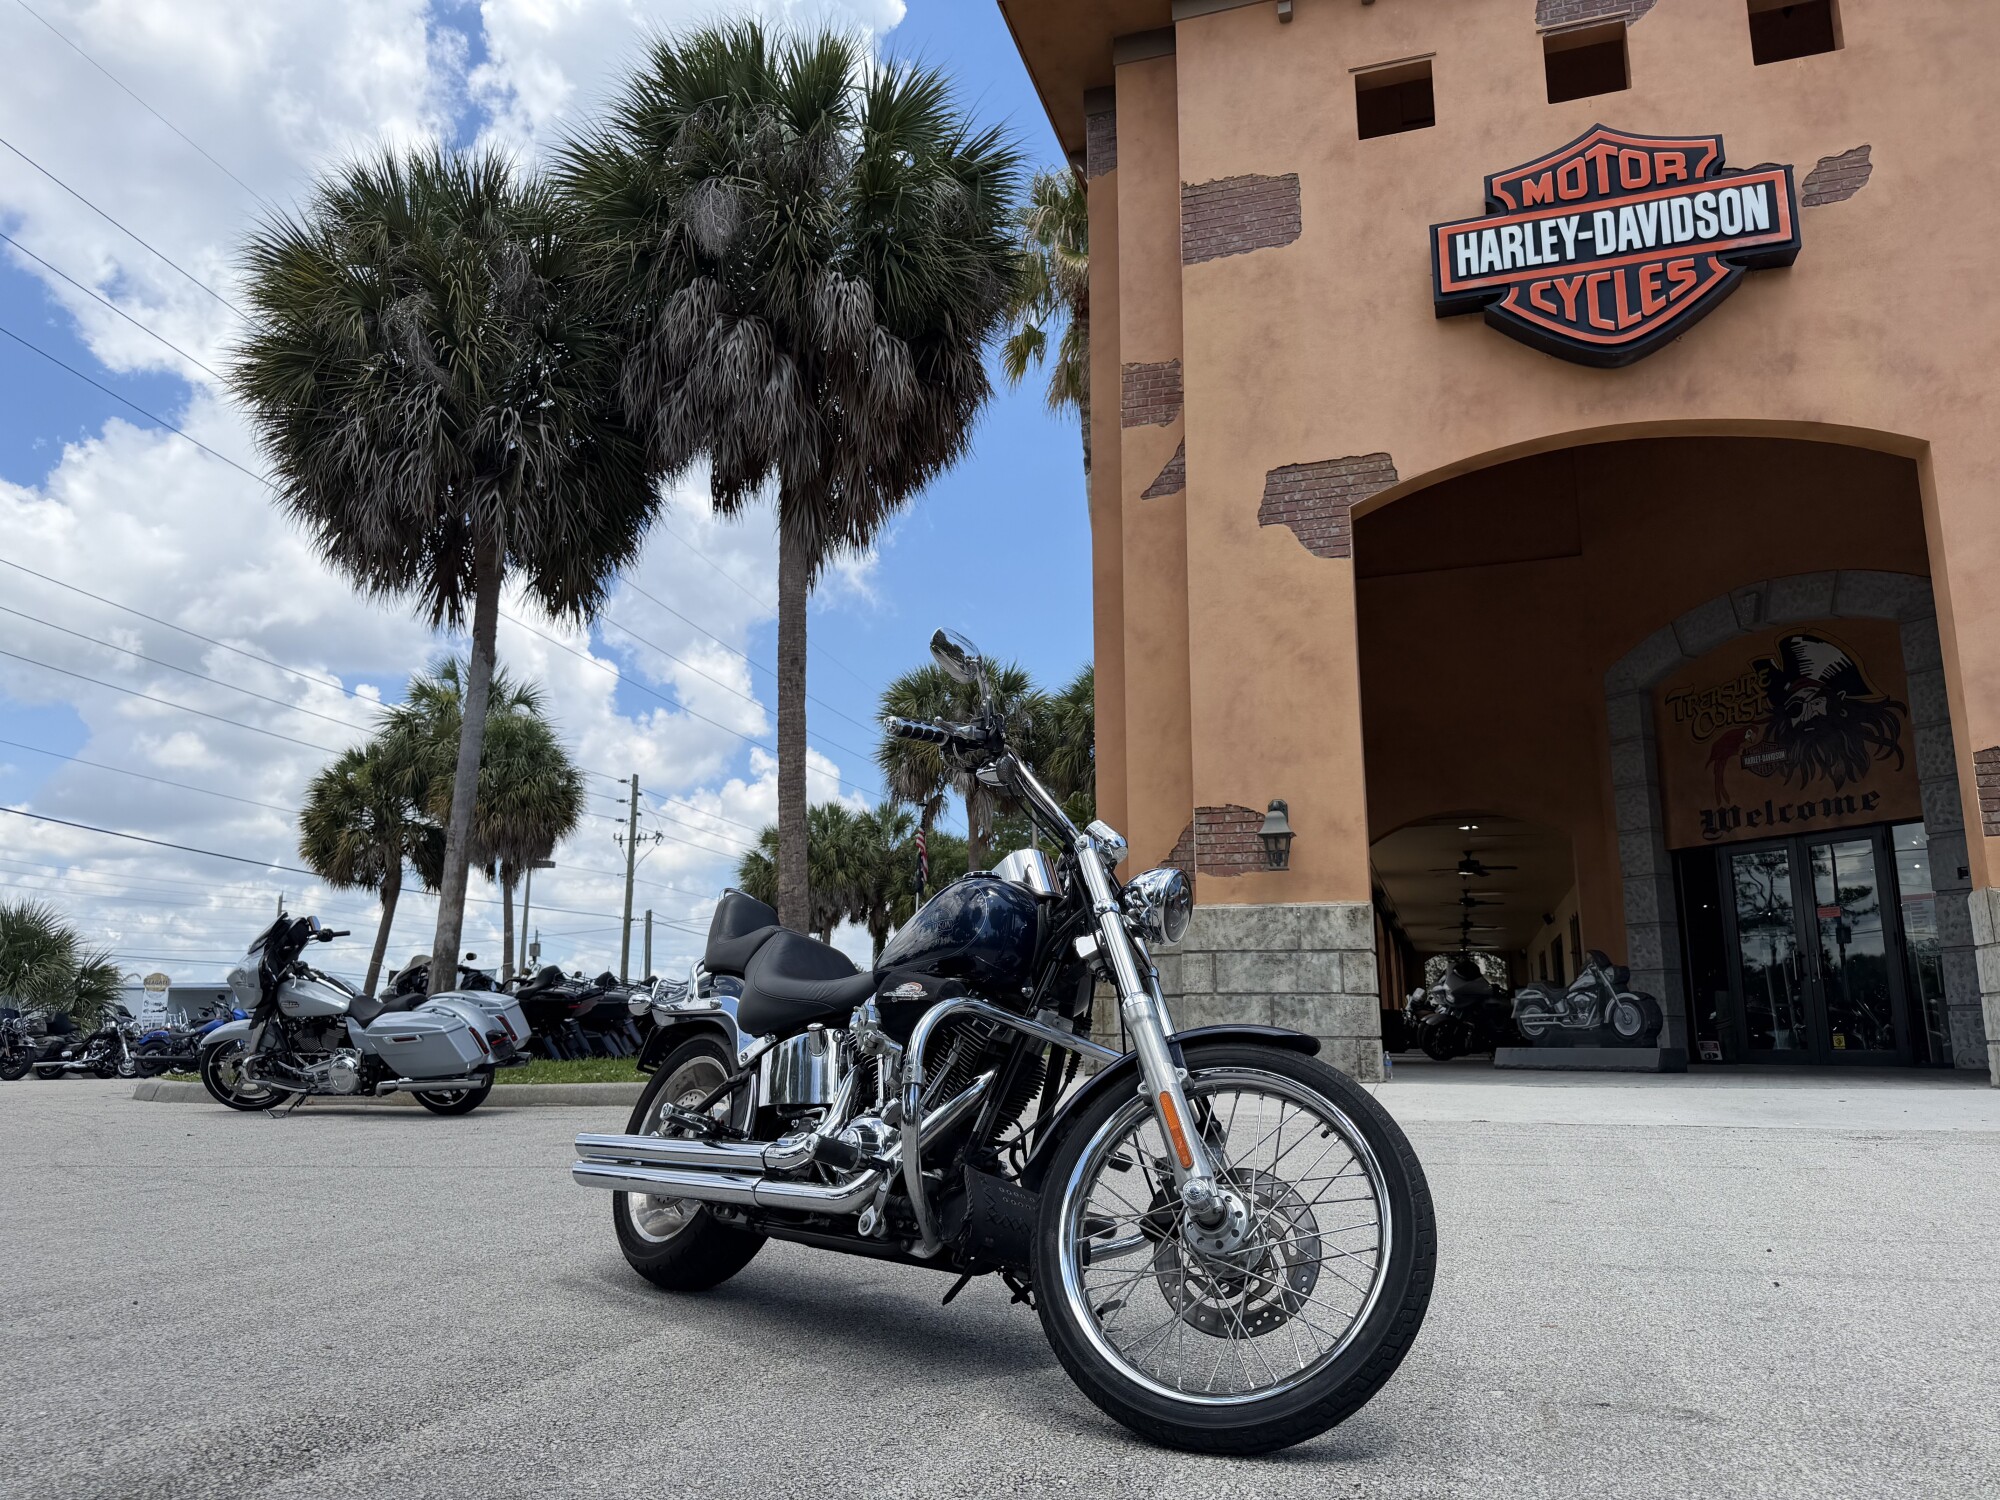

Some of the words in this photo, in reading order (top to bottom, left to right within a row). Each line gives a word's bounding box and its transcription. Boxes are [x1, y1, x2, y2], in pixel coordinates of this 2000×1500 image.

[1522, 143, 1688, 207] MOTOR
[1456, 184, 1770, 277] HARLEY-DAVIDSON
[1529, 257, 1697, 331] CYCLES
[1744, 751, 1785, 765] HARLEY-DAVIDSON
[1700, 790, 1880, 840] Welcome
